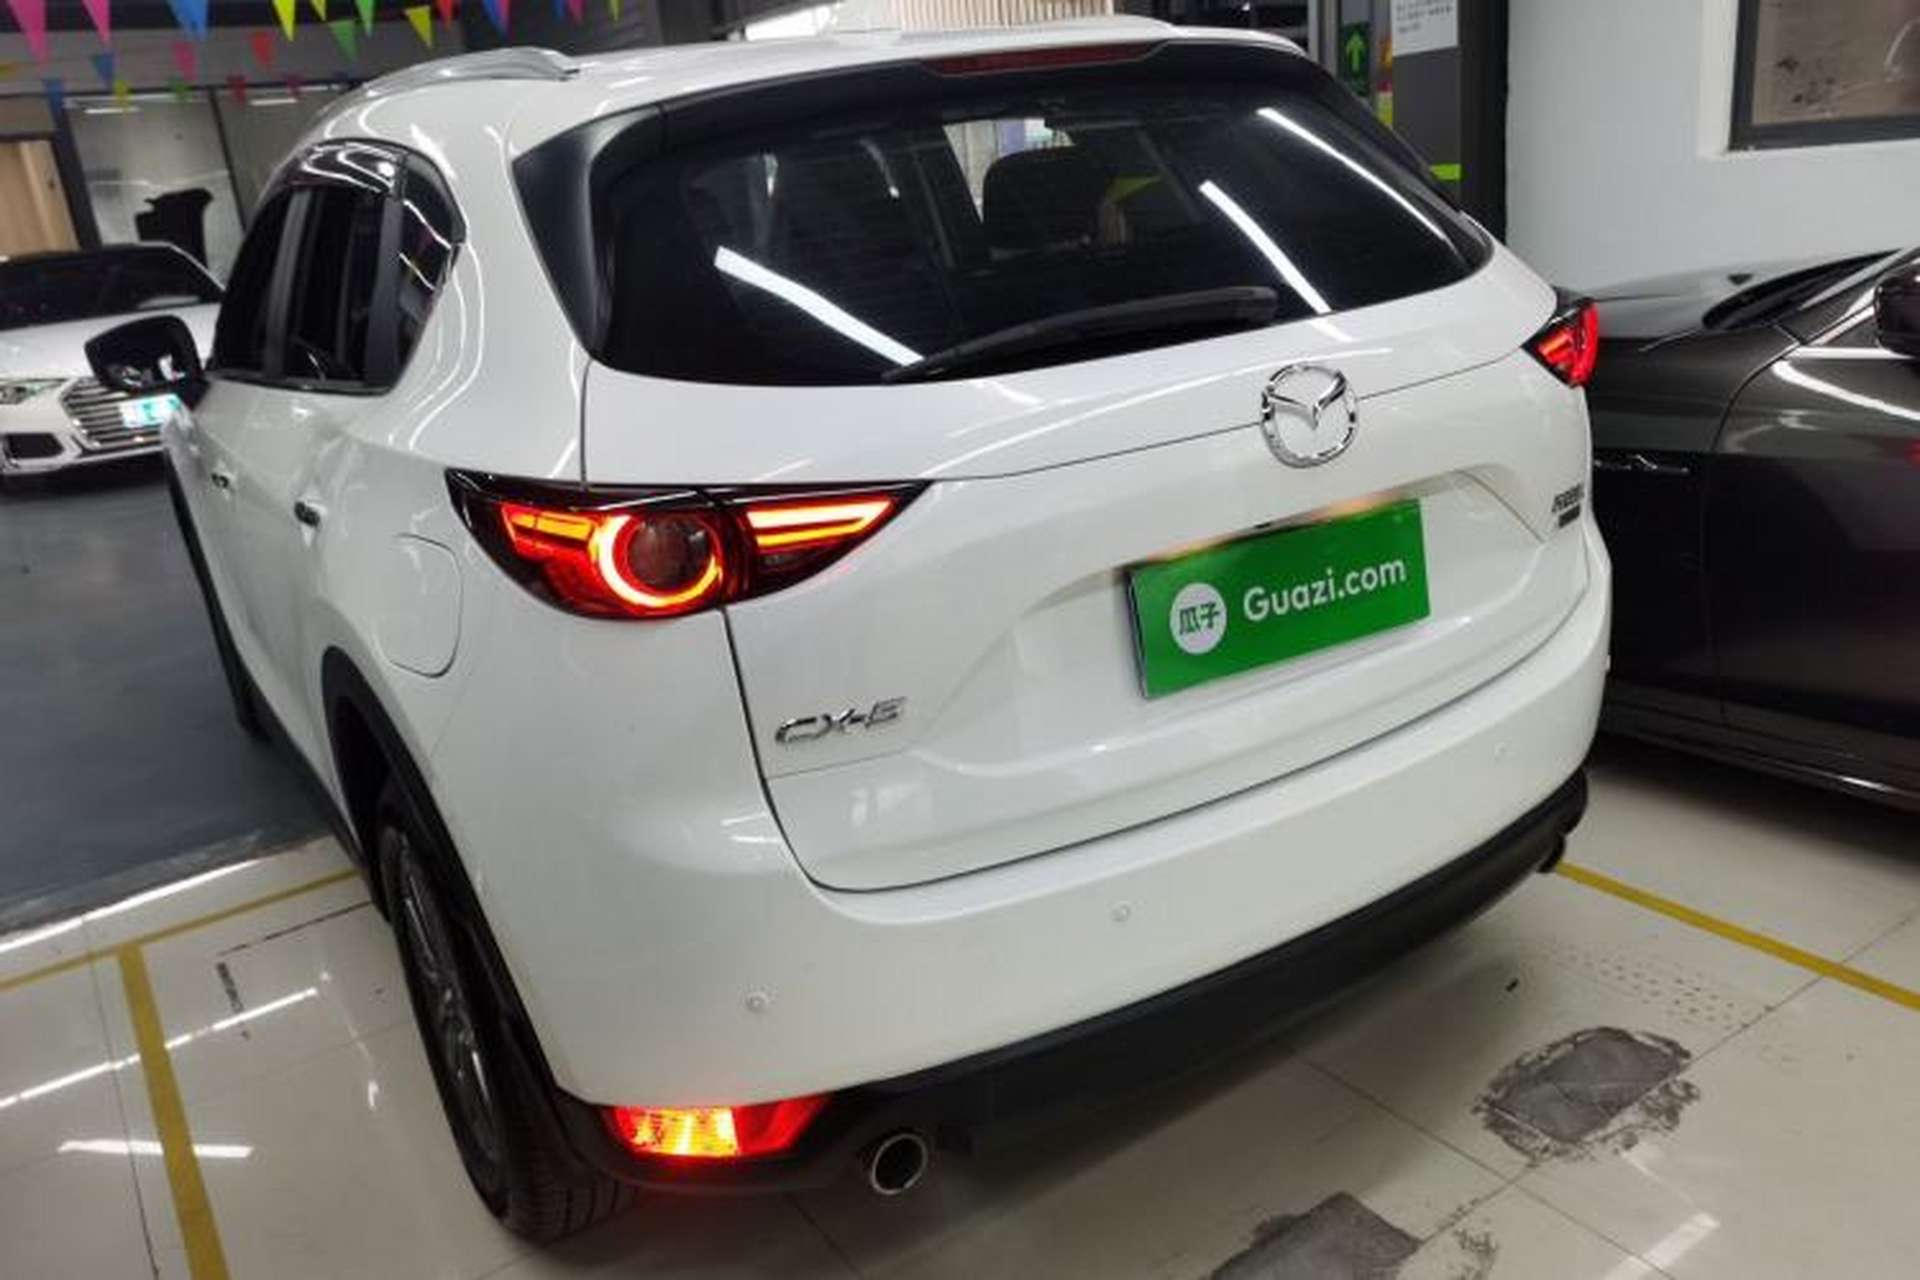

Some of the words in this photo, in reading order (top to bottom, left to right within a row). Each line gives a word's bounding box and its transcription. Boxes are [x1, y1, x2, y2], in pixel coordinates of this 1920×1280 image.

[1243, 558, 1407, 622] Guazi.com
[1178, 602, 1221, 636] 瓜子
[774, 696, 908, 744] CX-5
